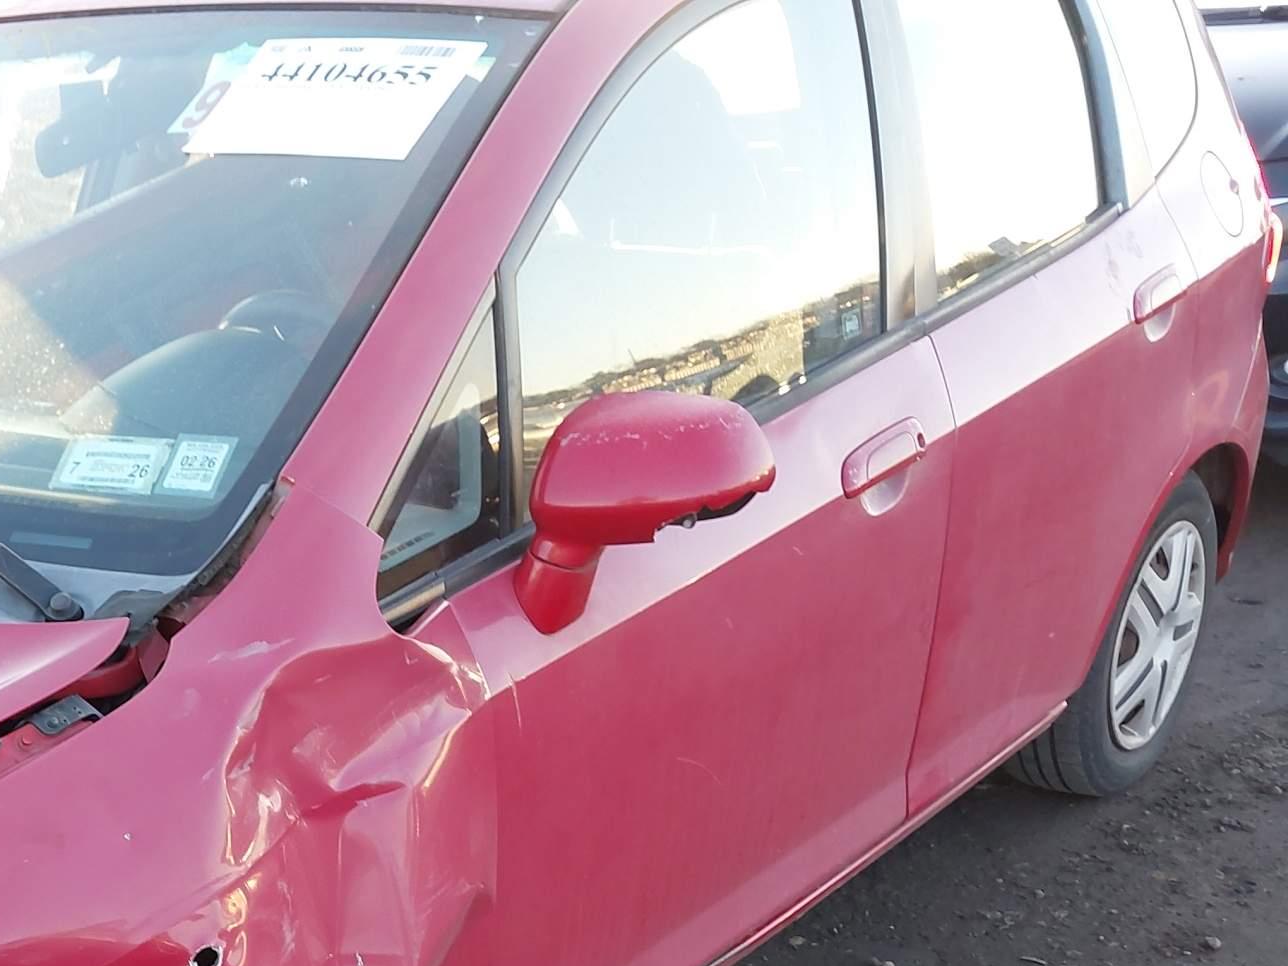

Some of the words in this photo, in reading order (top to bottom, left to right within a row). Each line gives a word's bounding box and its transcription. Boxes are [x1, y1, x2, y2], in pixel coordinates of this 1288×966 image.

[261, 62, 439, 86] 44104655
[182, 80, 232, 129] 9
[128, 463, 151, 479] 26
